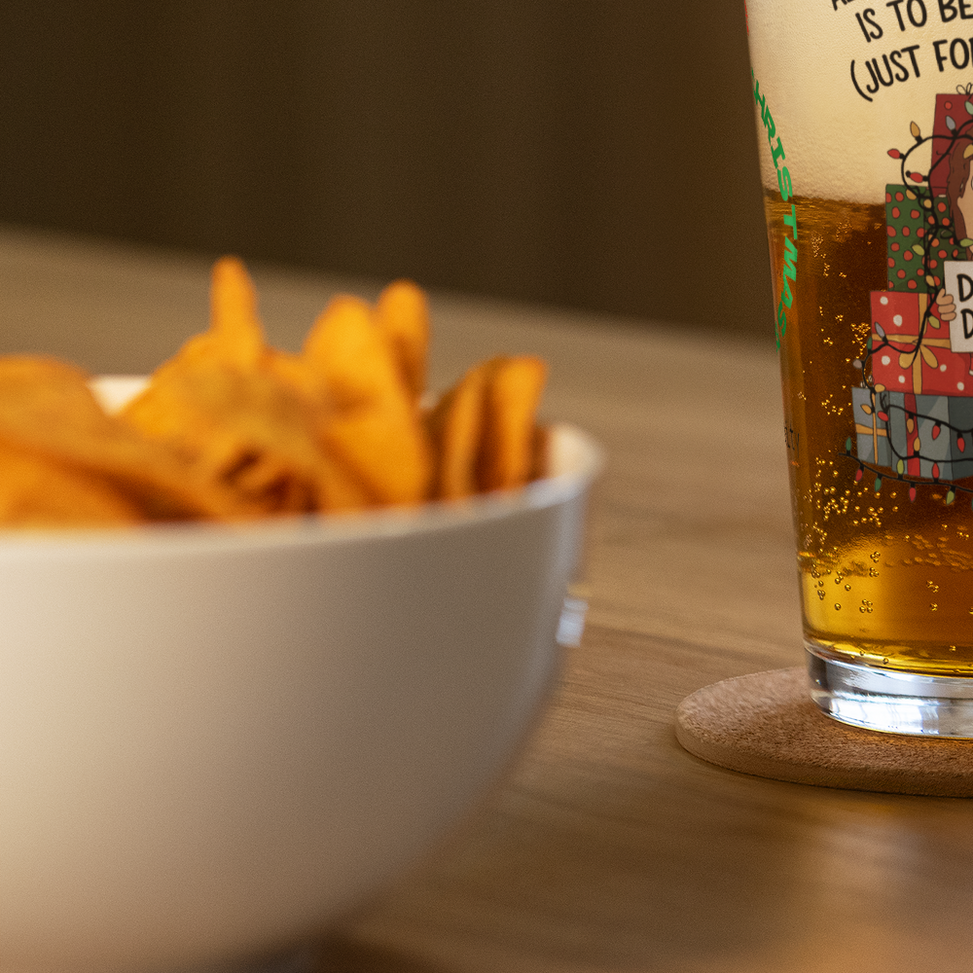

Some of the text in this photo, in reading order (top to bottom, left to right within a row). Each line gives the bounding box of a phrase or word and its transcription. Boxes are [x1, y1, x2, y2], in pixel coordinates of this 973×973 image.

[856, 8, 884, 43] IS
[850, 45, 921, 102] (JUST
[751, 67, 798, 337] HRISTMAS
